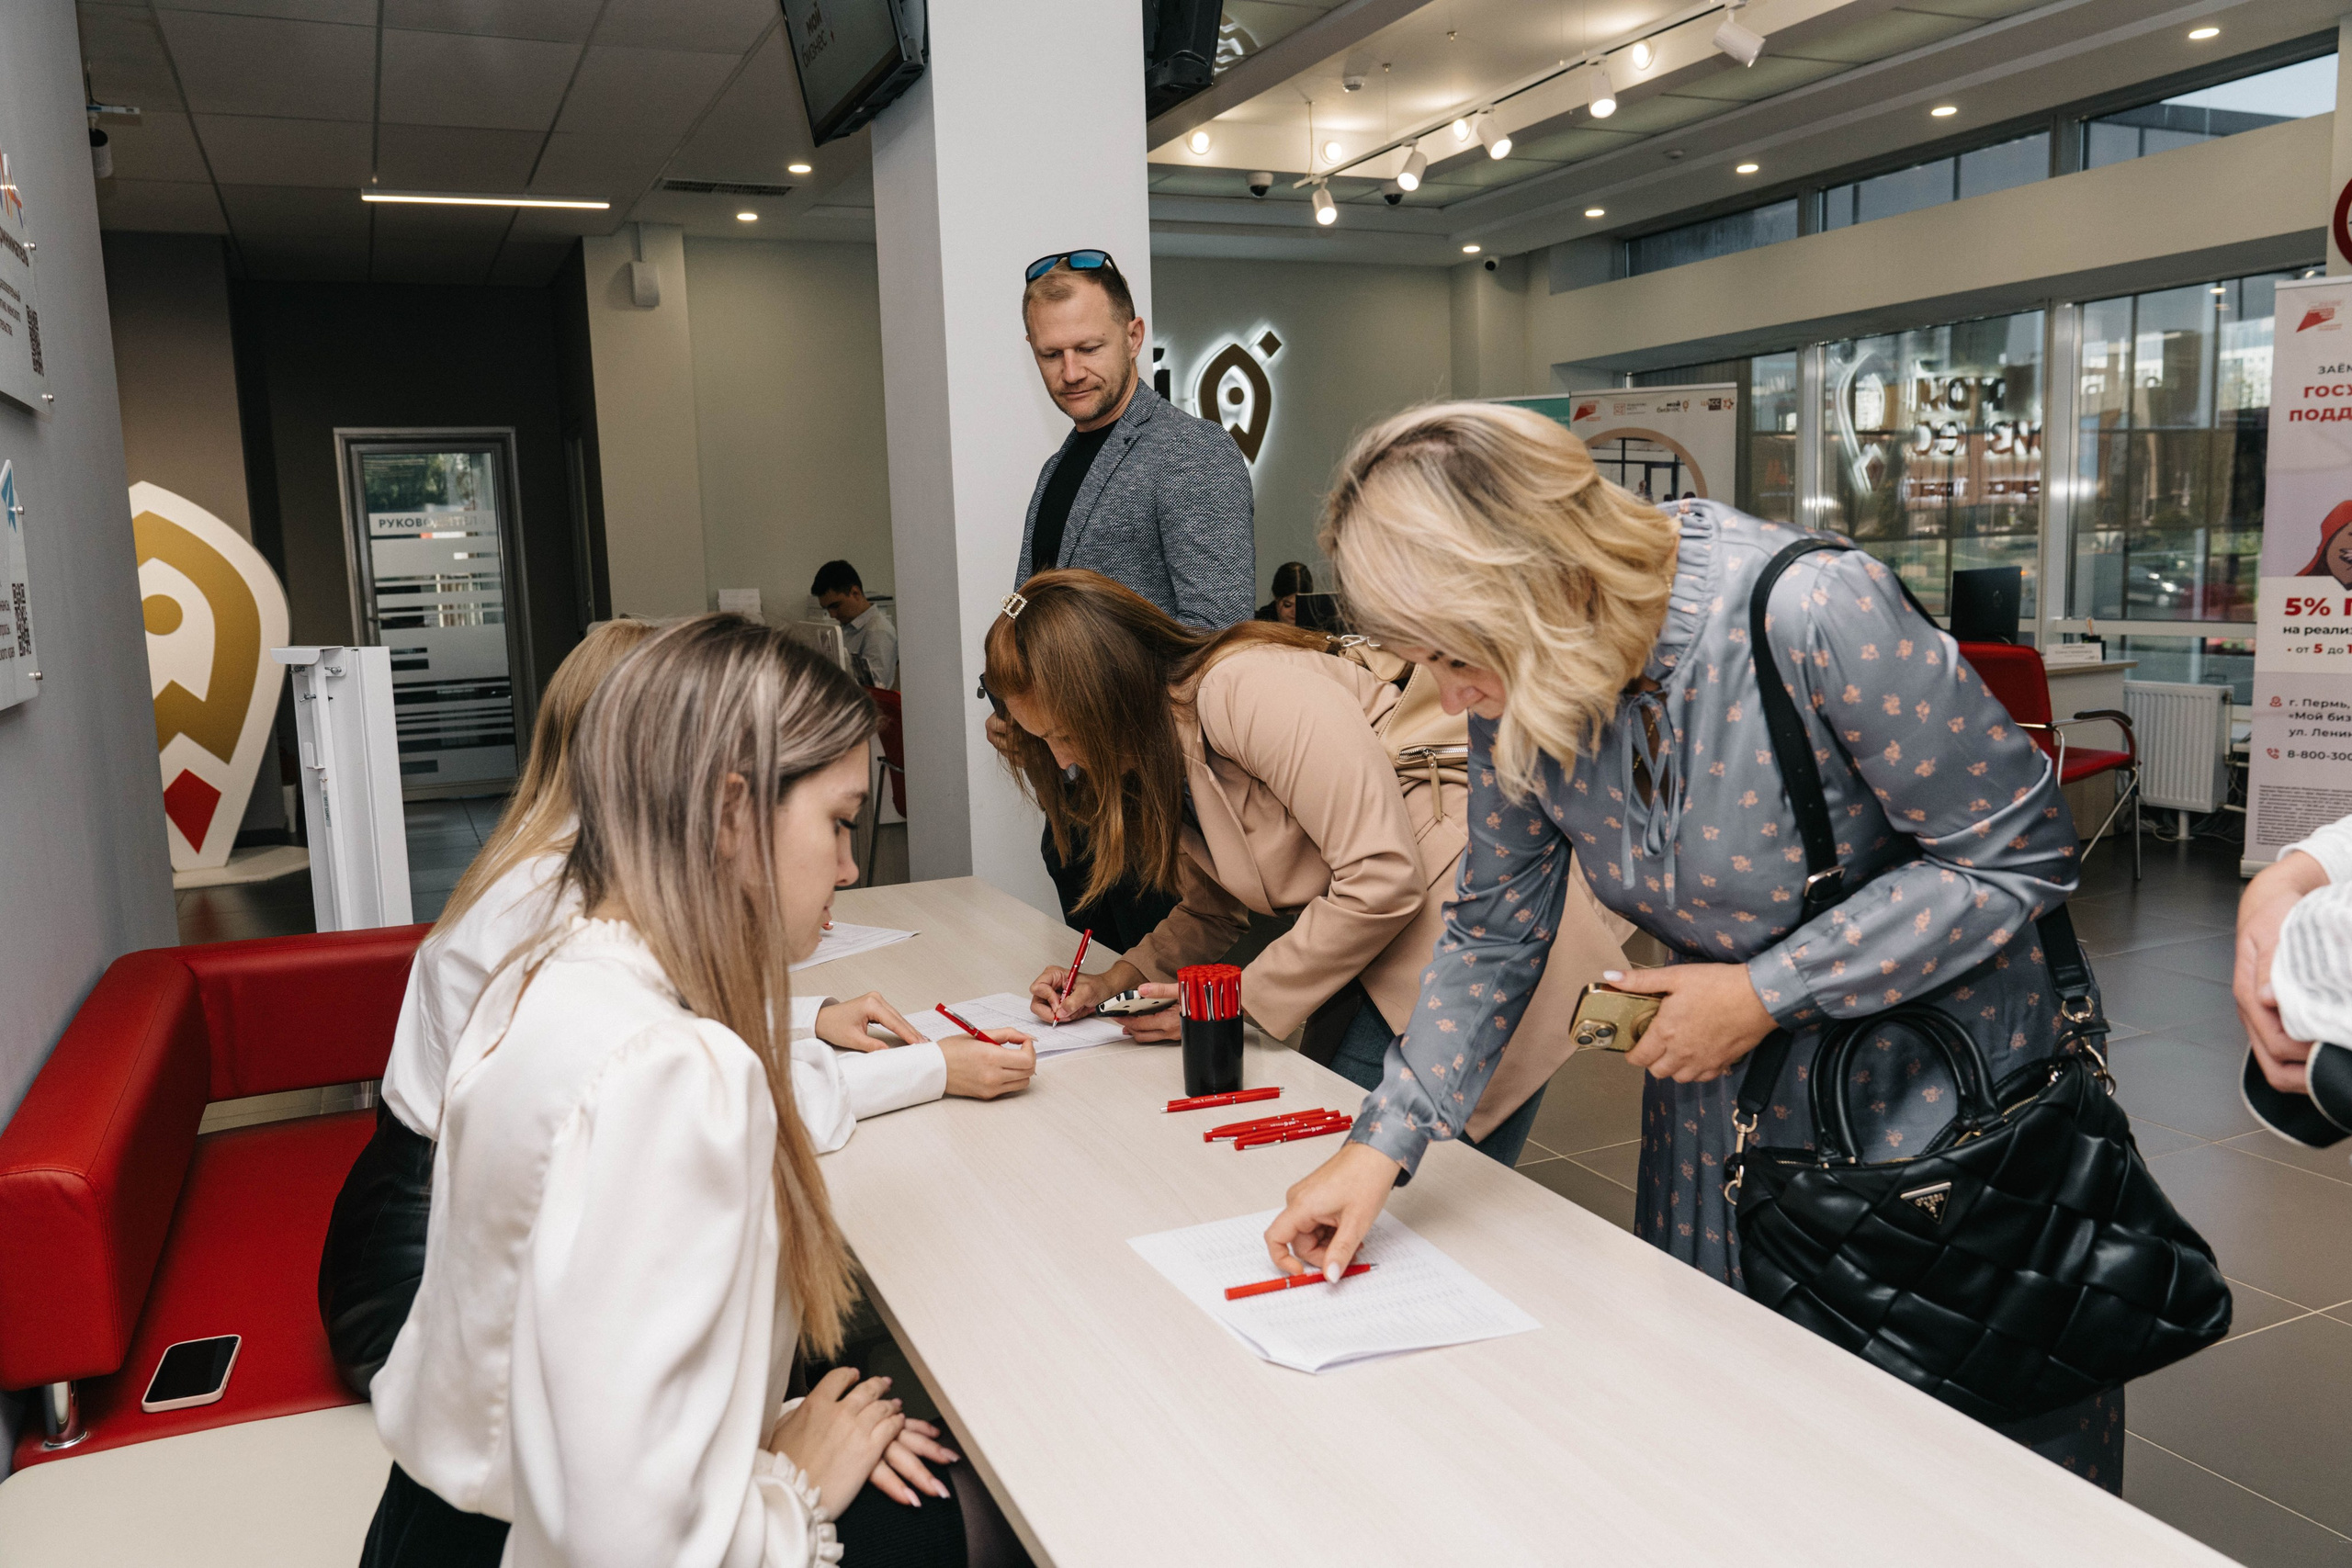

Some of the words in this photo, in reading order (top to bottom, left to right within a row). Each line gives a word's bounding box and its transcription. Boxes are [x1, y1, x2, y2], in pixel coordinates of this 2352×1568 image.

[2284, 597, 2331, 616] 5%
[2313, 643, 2324, 654] 5
[2327, 647, 2345, 655] до
[2302, 699, 2350, 709] Пермь,
[2289, 728, 2308, 738] ул.
